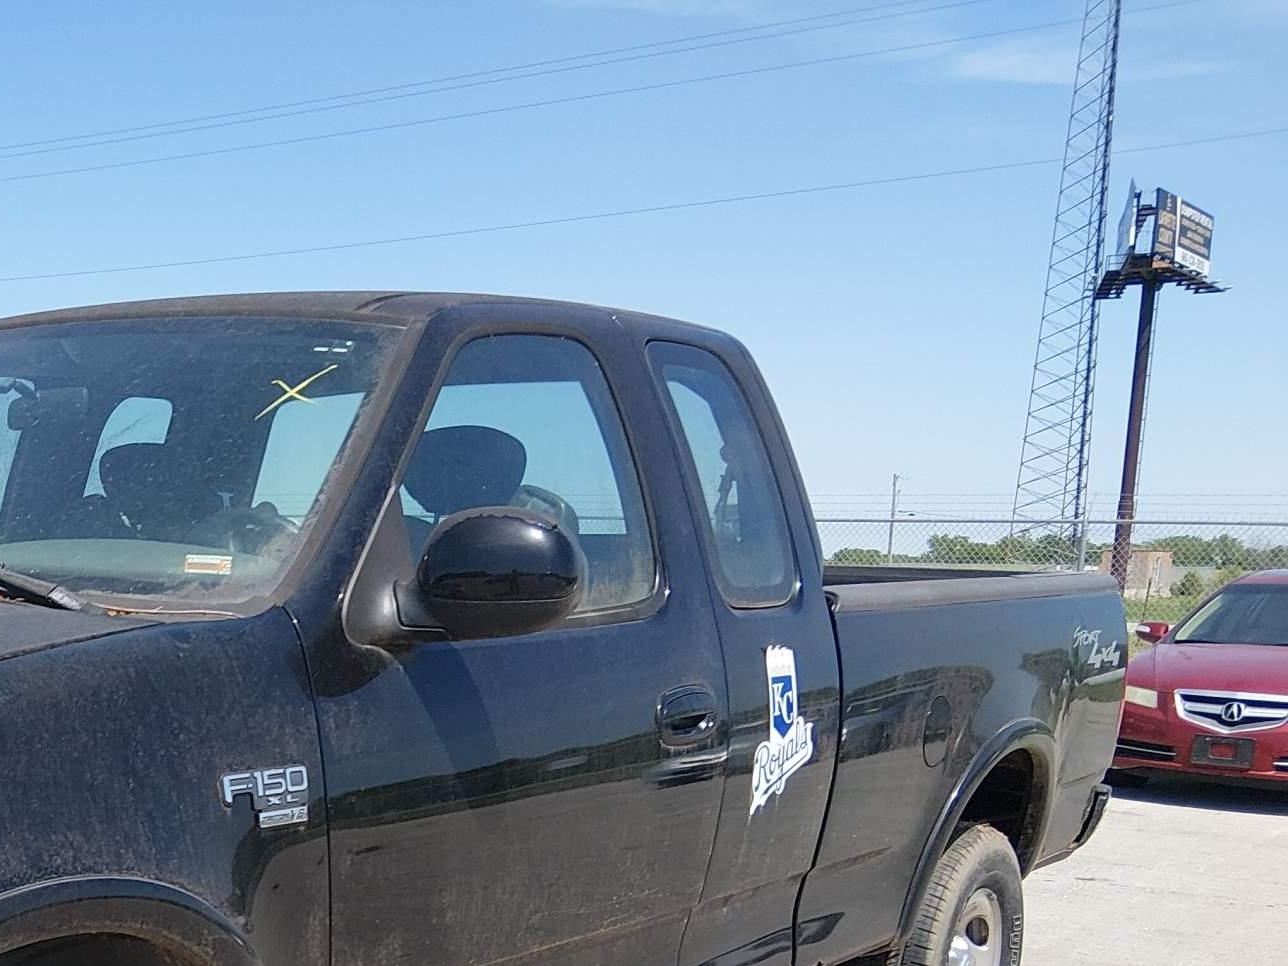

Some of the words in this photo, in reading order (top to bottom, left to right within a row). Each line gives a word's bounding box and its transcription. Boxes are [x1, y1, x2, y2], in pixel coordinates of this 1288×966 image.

[772, 682, 794, 724] KC
[752, 717, 812, 796] Royals
[266, 794, 300, 806] XL
